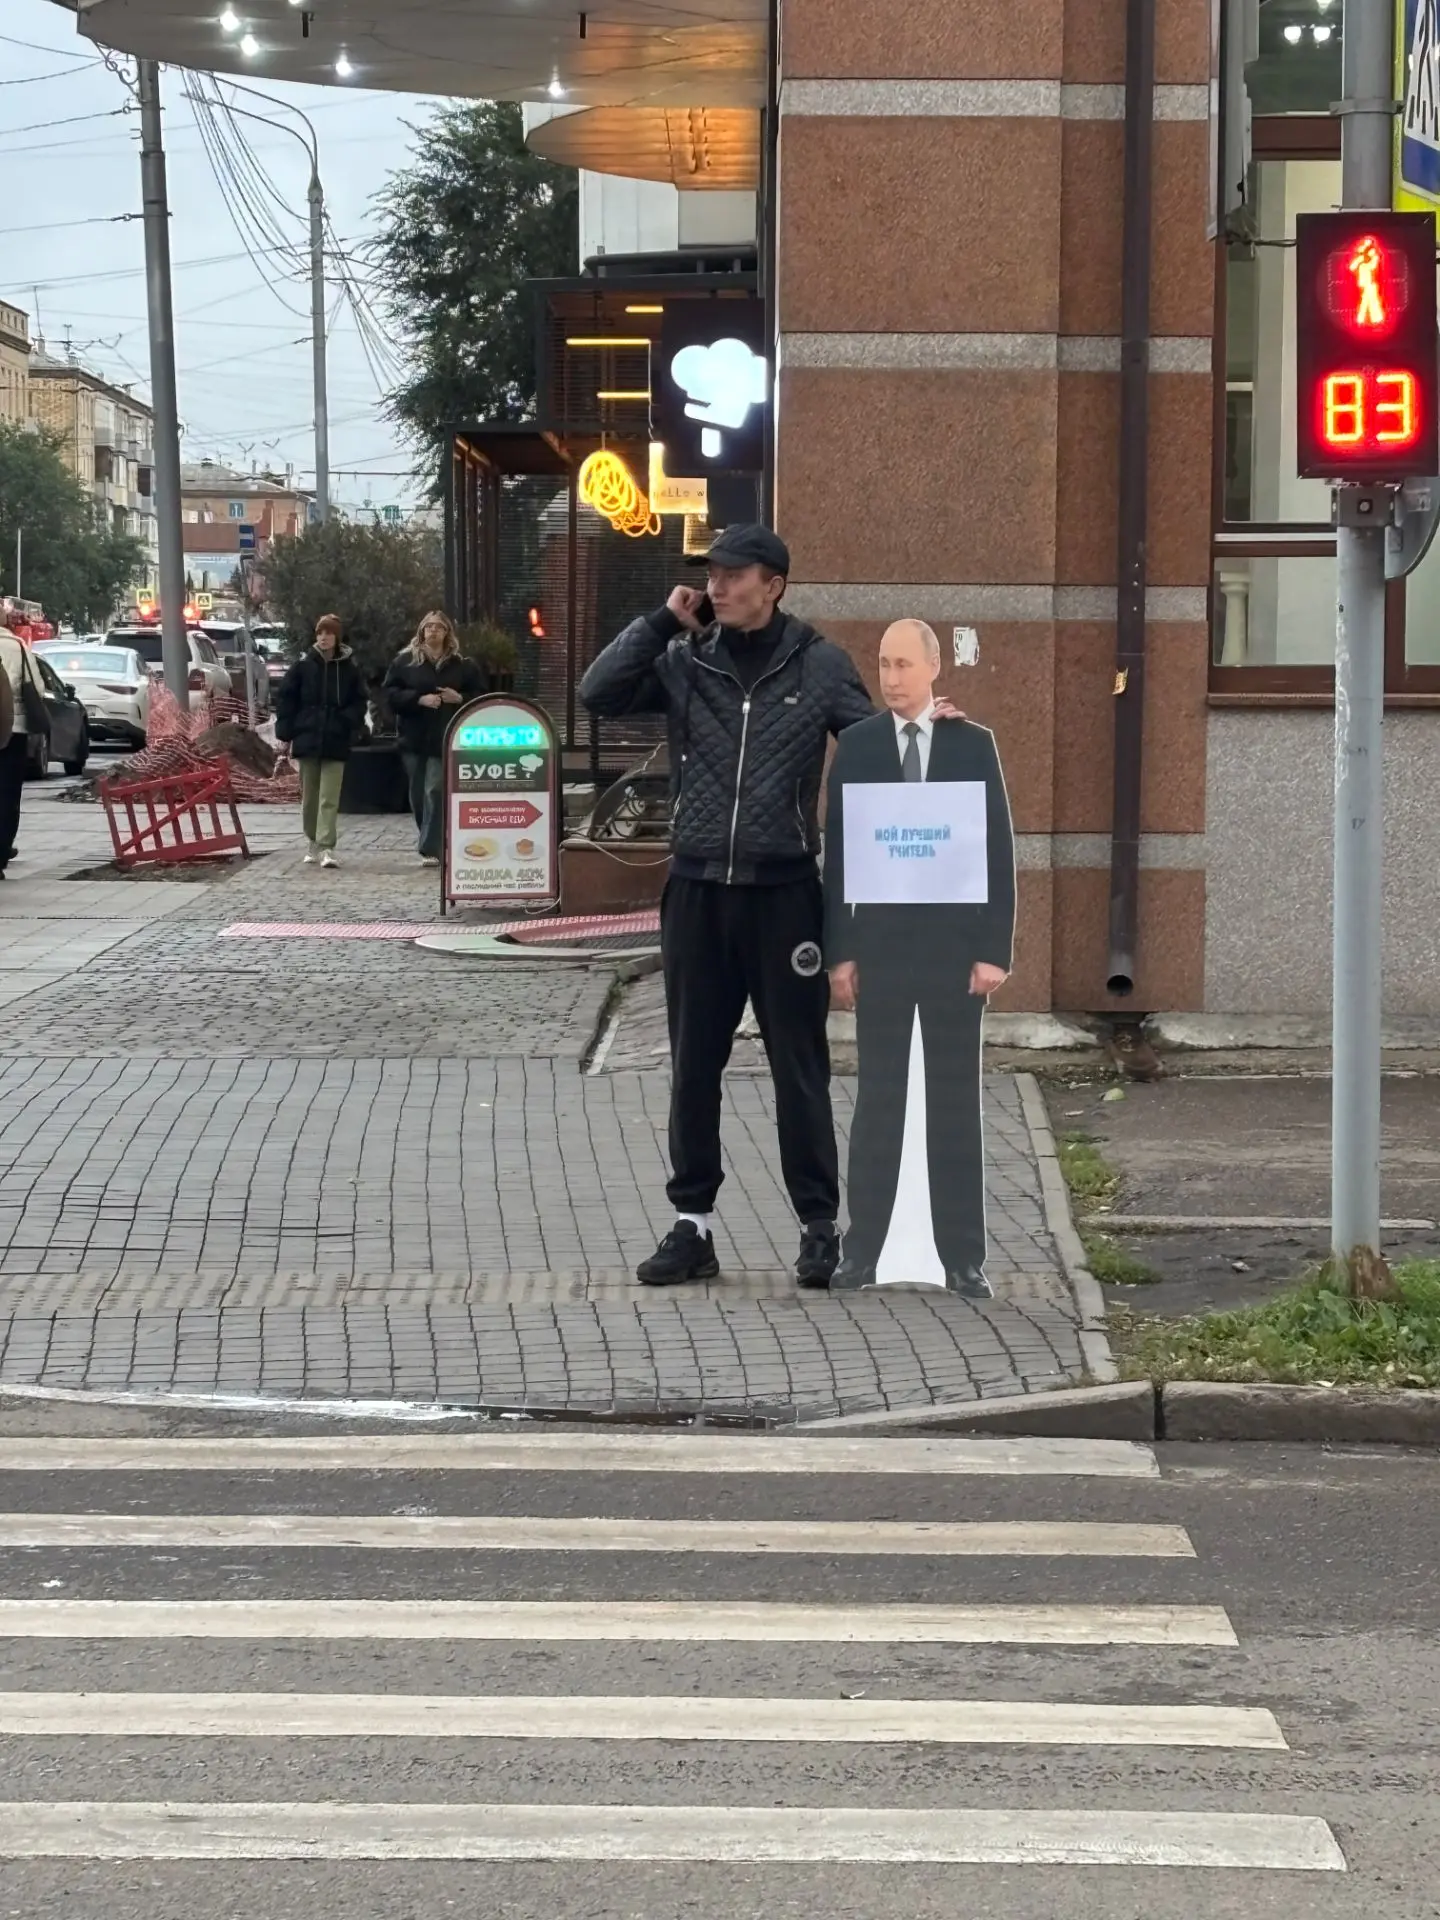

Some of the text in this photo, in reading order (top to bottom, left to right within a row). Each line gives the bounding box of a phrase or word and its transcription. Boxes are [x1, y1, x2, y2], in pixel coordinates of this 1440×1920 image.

[1325, 374, 1412, 443] 83
[874, 824, 952, 842] МОЙ ЛУЧШИЙ
[888, 844, 937, 859] УЧИТЕЛЬ
[454, 868, 513, 882] СКИДКА
